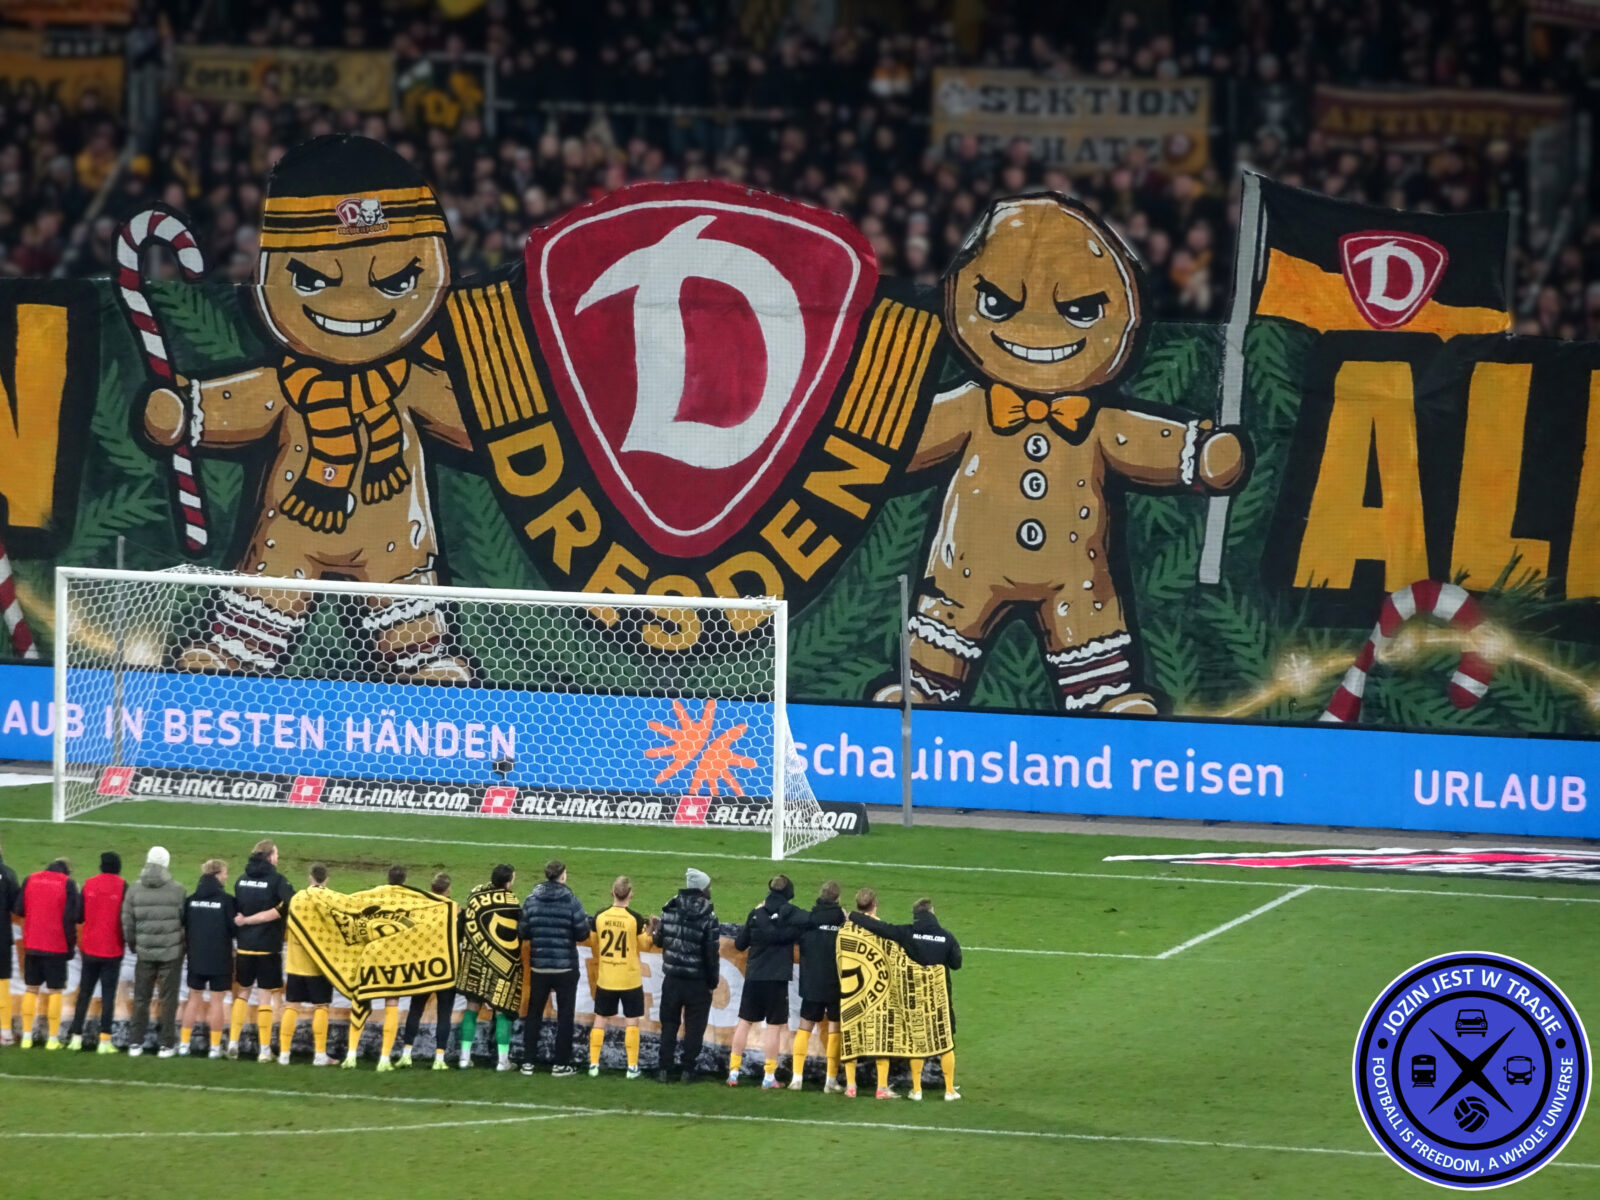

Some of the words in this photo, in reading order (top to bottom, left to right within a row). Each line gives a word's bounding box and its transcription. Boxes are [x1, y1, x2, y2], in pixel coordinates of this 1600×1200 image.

[979, 85, 1200, 116] SEKTION
[1352, 241, 1425, 312] D
[574, 215, 806, 470] D
[488, 421, 891, 652] DRESDEN
[105, 704, 144, 742] IN
[164, 707, 326, 751] BESTEN
[346, 708, 515, 760] HÄNDEN
[136, 776, 278, 800] ALL-INKL.COM
[786, 732, 1112, 789] schauinsland
[1131, 748, 1284, 798] reisen
[329, 785, 470, 810] ALL-INKL.COM
[520, 795, 662, 820] ALL-INKL.COM
[1413, 768, 1587, 813] URLAUB
[465, 892, 506, 957] DRESDEN
[601, 929, 629, 958] 24
